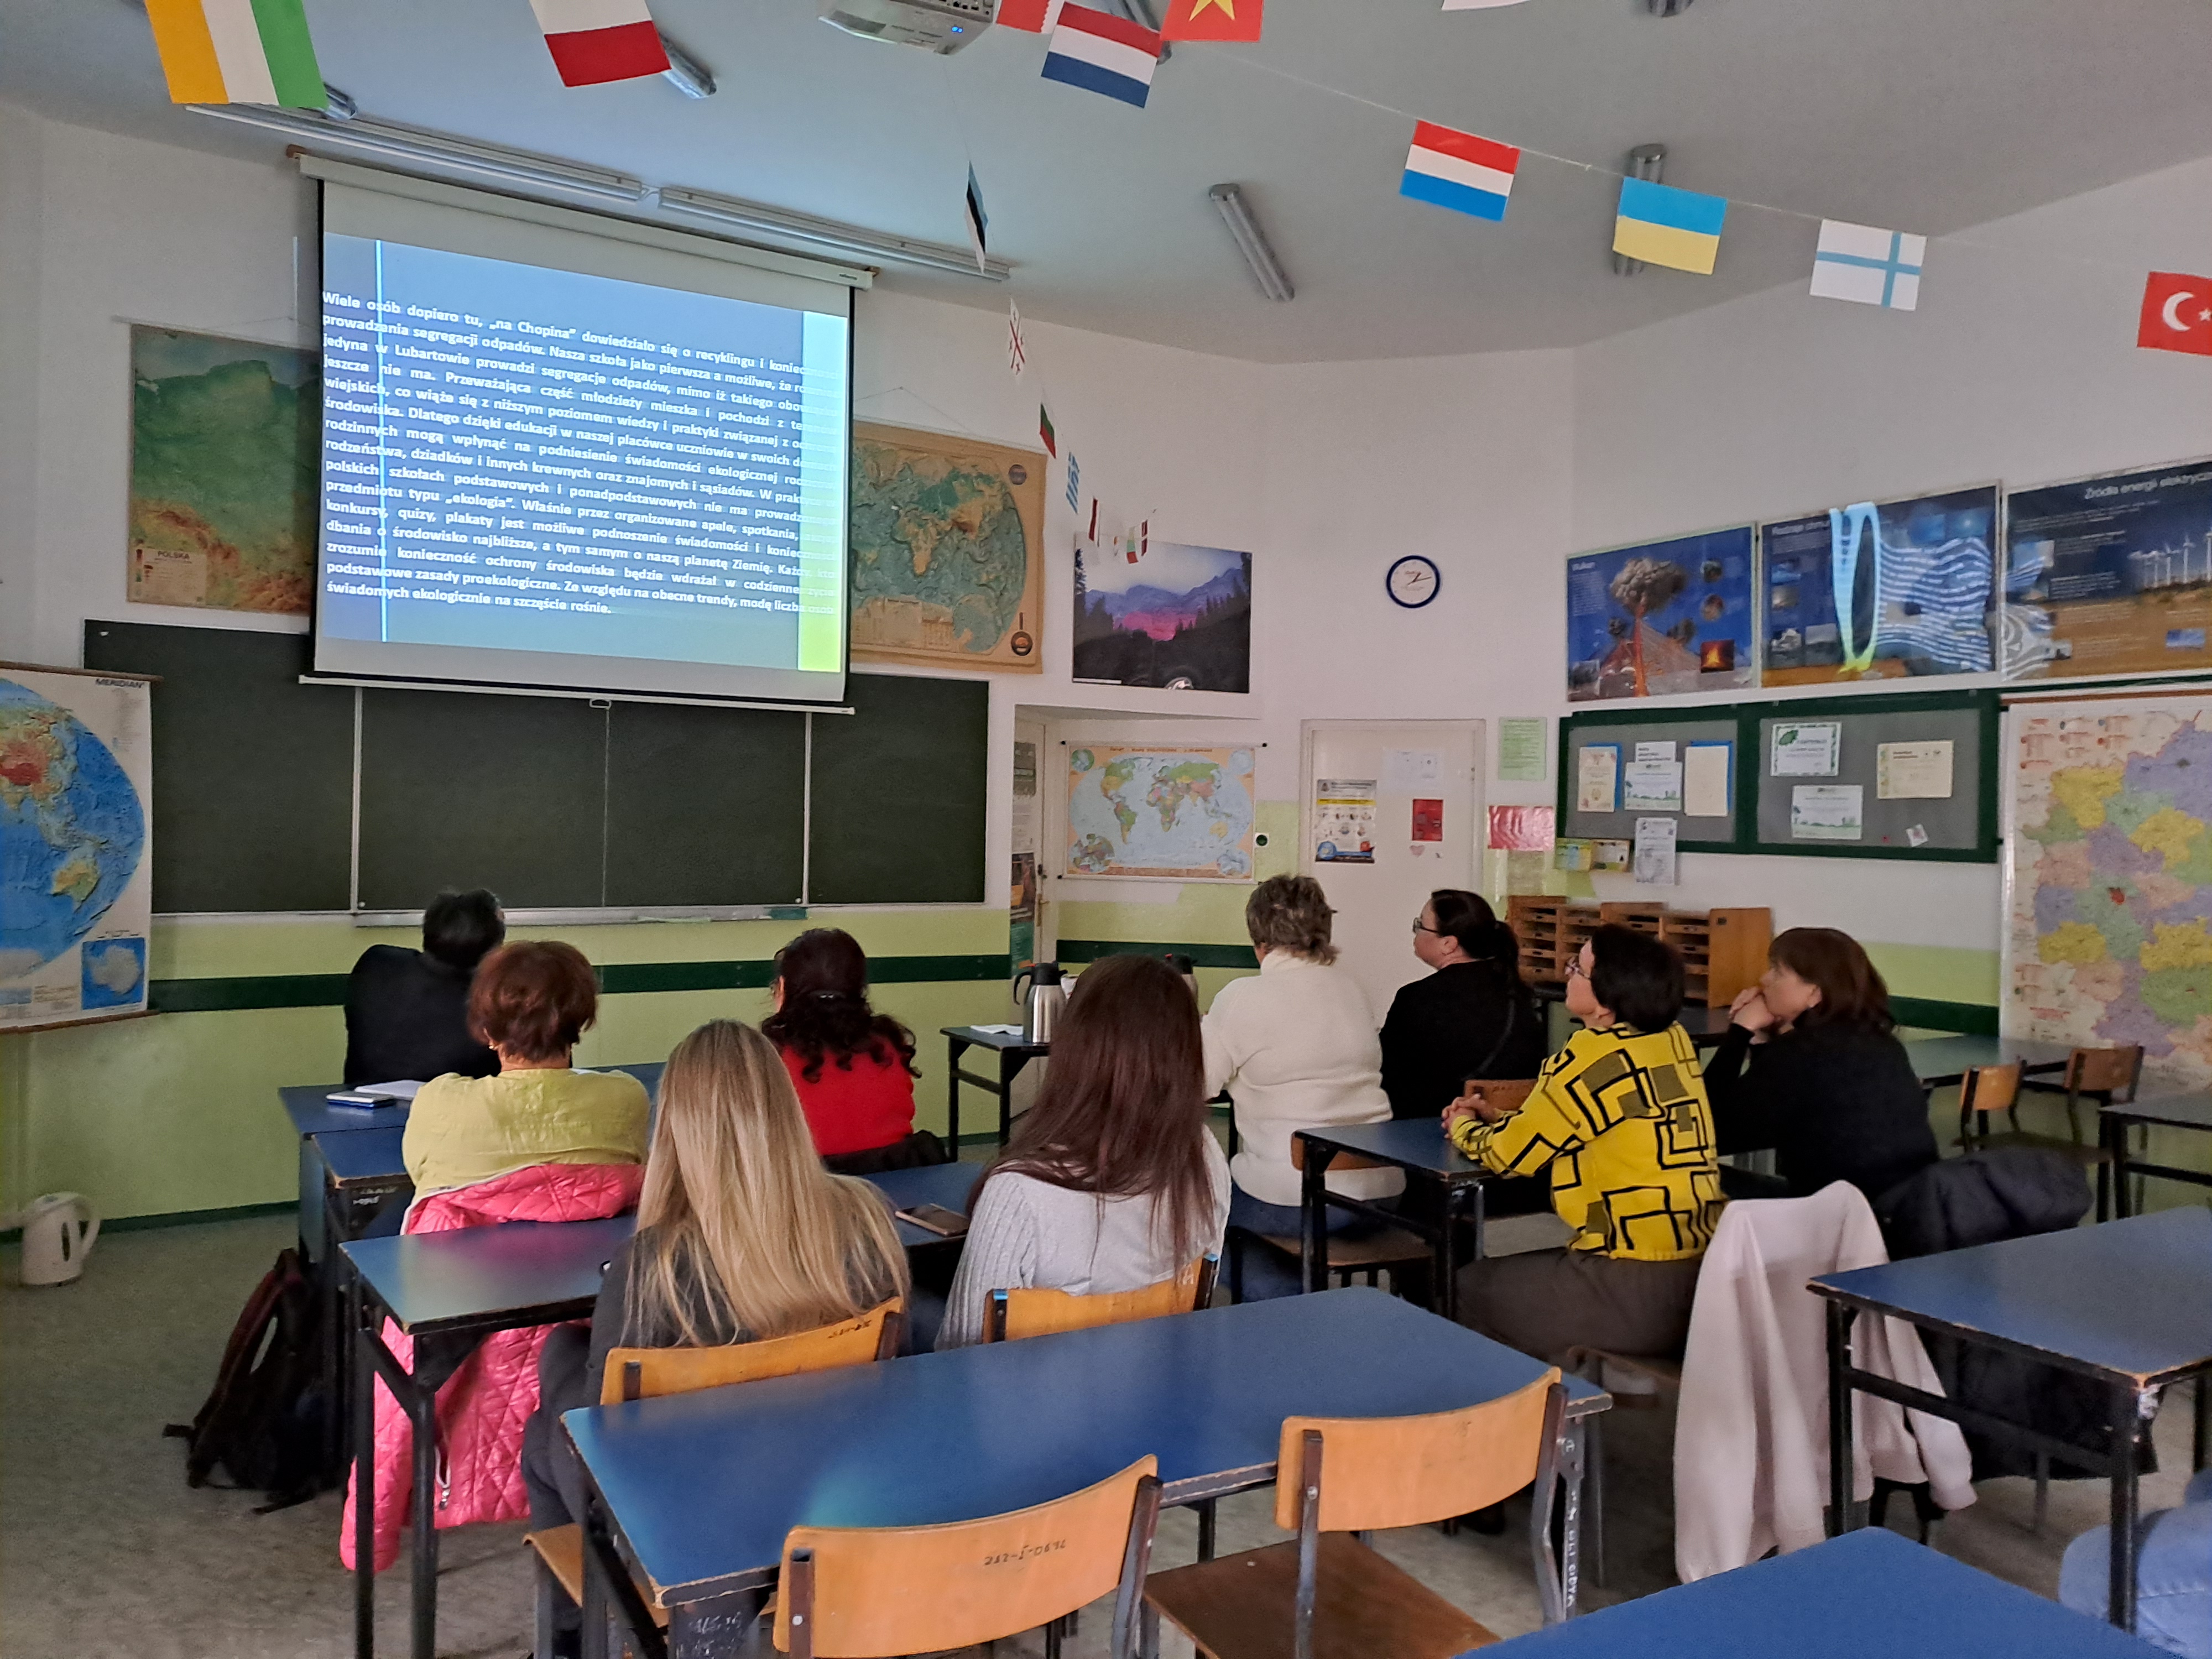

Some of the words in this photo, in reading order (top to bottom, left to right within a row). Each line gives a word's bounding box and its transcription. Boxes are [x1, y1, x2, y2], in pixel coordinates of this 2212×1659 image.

[323, 291, 360, 309] Wiele
[367, 301, 401, 315] osób
[407, 305, 459, 324] dopiero
[464, 313, 483, 330] tu,
[489, 320, 512, 332] „na
[518, 321, 576, 340] Chopina”
[582, 331, 656, 352] dowiedziało
[661, 343, 679, 358] się
[682, 348, 691, 357] o
[696, 349, 754, 368] recyklingu
[760, 357, 764, 367] i
[413, 328, 478, 348] segregacji
[482, 336, 545, 355] odpadów.
[550, 345, 585, 361] Nasza
[589, 352, 627, 367] szkoła
[630, 357, 655, 371] jako
[660, 362, 710, 378] pierwsza
[714, 371, 722, 380] a
[725, 372, 775, 390] możliwe,
[779, 378, 791, 389] że
[323, 333, 368, 352] jedyna
[374, 343, 388, 354] w
[395, 343, 470, 364] Lubartowie
[476, 357, 535, 373] prowadzi
[612, 374, 670, 394] odpadów,
[677, 384, 711, 397] mimo
[716, 388, 726, 399] iż
[731, 390, 773, 408] takiego
[324, 354, 369, 372] jeszcze
[379, 363, 401, 375] nie
[410, 368, 436, 380] ma.
[446, 371, 531, 394] Przeważająca
[540, 385, 574, 399] część
[581, 390, 643, 410] młodzieży
[651, 399, 697, 414] mieszka
[706, 405, 709, 416] i
[718, 409, 769, 424] pochodzi
[778, 417, 784, 426] z
[324, 377, 390, 398] wiejskich,
[395, 387, 411, 397] co
[416, 388, 453, 404] wiąże
[458, 393, 477, 409] się
[482, 398, 489, 407] z
[494, 398, 543, 415] niższym
[548, 406, 613, 422] poziomem
[617, 414, 659, 431] wiedzy
[664, 419, 667, 430] i
[672, 422, 718, 437] praktyki
[723, 429, 778, 446] związanej
[782, 436, 789, 445] z
[325, 396, 404, 416] środowiska.
[409, 406, 460, 425] Dlatego
[463, 413, 501, 430] dzięki
[504, 419, 557, 437] edukacji
[560, 427, 572, 437] w
[576, 429, 613, 445] naszej
[618, 433, 673, 450] placówce
[677, 442, 734, 457] uczniowie
[737, 449, 748, 458] w
[751, 451, 789, 463] swoich
[325, 418, 398, 437] rodzinnych
[406, 429, 444, 444] mogą
[452, 434, 507, 451] wpłynąć
[515, 441, 530, 452] na
[539, 444, 617, 462] podniesienie
[625, 452, 701, 472] świadomości
[708, 463, 778, 483] ekologicznej
[325, 439, 406, 460] rodzeństwa,
[411, 447, 473, 465] dziadków
[477, 455, 482, 466] i
[486, 456, 528, 472] innych
[532, 461, 591, 479] krewnych
[596, 471, 623, 482] oraz
[625, 474, 688, 490] znajomych
[692, 479, 696, 490] i
[700, 482, 754, 497] sąsiadów.
[759, 487, 772, 498] W
[326, 459, 379, 474] polskich
[388, 466, 445, 482] szkołach
[454, 473, 549, 494] podstawowych
[557, 483, 561, 494] i
[570, 487, 696, 510] ponadpodstawowych
[704, 500, 722, 512] nie
[730, 504, 747, 514] ma
[326, 481, 402, 497] przedmiotu
[408, 487, 440, 503] typu
[446, 492, 515, 509] „ekologia”.
[522, 499, 571, 514] Właśnie
[578, 507, 609, 519] przez
[614, 511, 697, 528] organizowane
[702, 520, 737, 534] apele,
[742, 524, 799, 541] spotkania,
[326, 519, 371, 534] dbania
[393, 525, 468, 543] środowisko
[473, 534, 537, 552] najbliższe,
[542, 542, 550, 551] a
[556, 541, 580, 556] tym
[585, 546, 630, 560] samym
[646, 552, 679, 566] naszą
[685, 554, 728, 571] planetę
[732, 559, 773, 575] Ziemię.
[398, 507, 436, 523] quizy,
[446, 512, 493, 529] plakaty
[502, 516, 525, 530] jest
[533, 521, 585, 535] możliwe
[593, 527, 668, 544] podnoszenie
[675, 534, 748, 551] świadomości
[755, 542, 759, 552] i
[327, 561, 412, 578] podstawowe
[415, 570, 460, 585] zasady
[463, 574, 561, 591] proekologiczne.
[564, 580, 579, 592] Ze
[581, 584, 631, 598] względu
[634, 589, 649, 598] na
[652, 589, 695, 602] obecne
[696, 592, 738, 608] trendy,
[740, 598, 772, 611] modę
[398, 546, 477, 564] konieczność
[485, 555, 537, 572] ochrony
[546, 560, 616, 576] środowiska
[624, 567, 664, 581] będzie
[671, 572, 718, 586] wdrażał
[725, 578, 737, 587] w
[327, 580, 409, 599] świadomych
[413, 587, 490, 604] ekologicznie
[495, 596, 510, 606] na
[514, 598, 567, 611] szczęście
[571, 601, 612, 614] rośnie.
